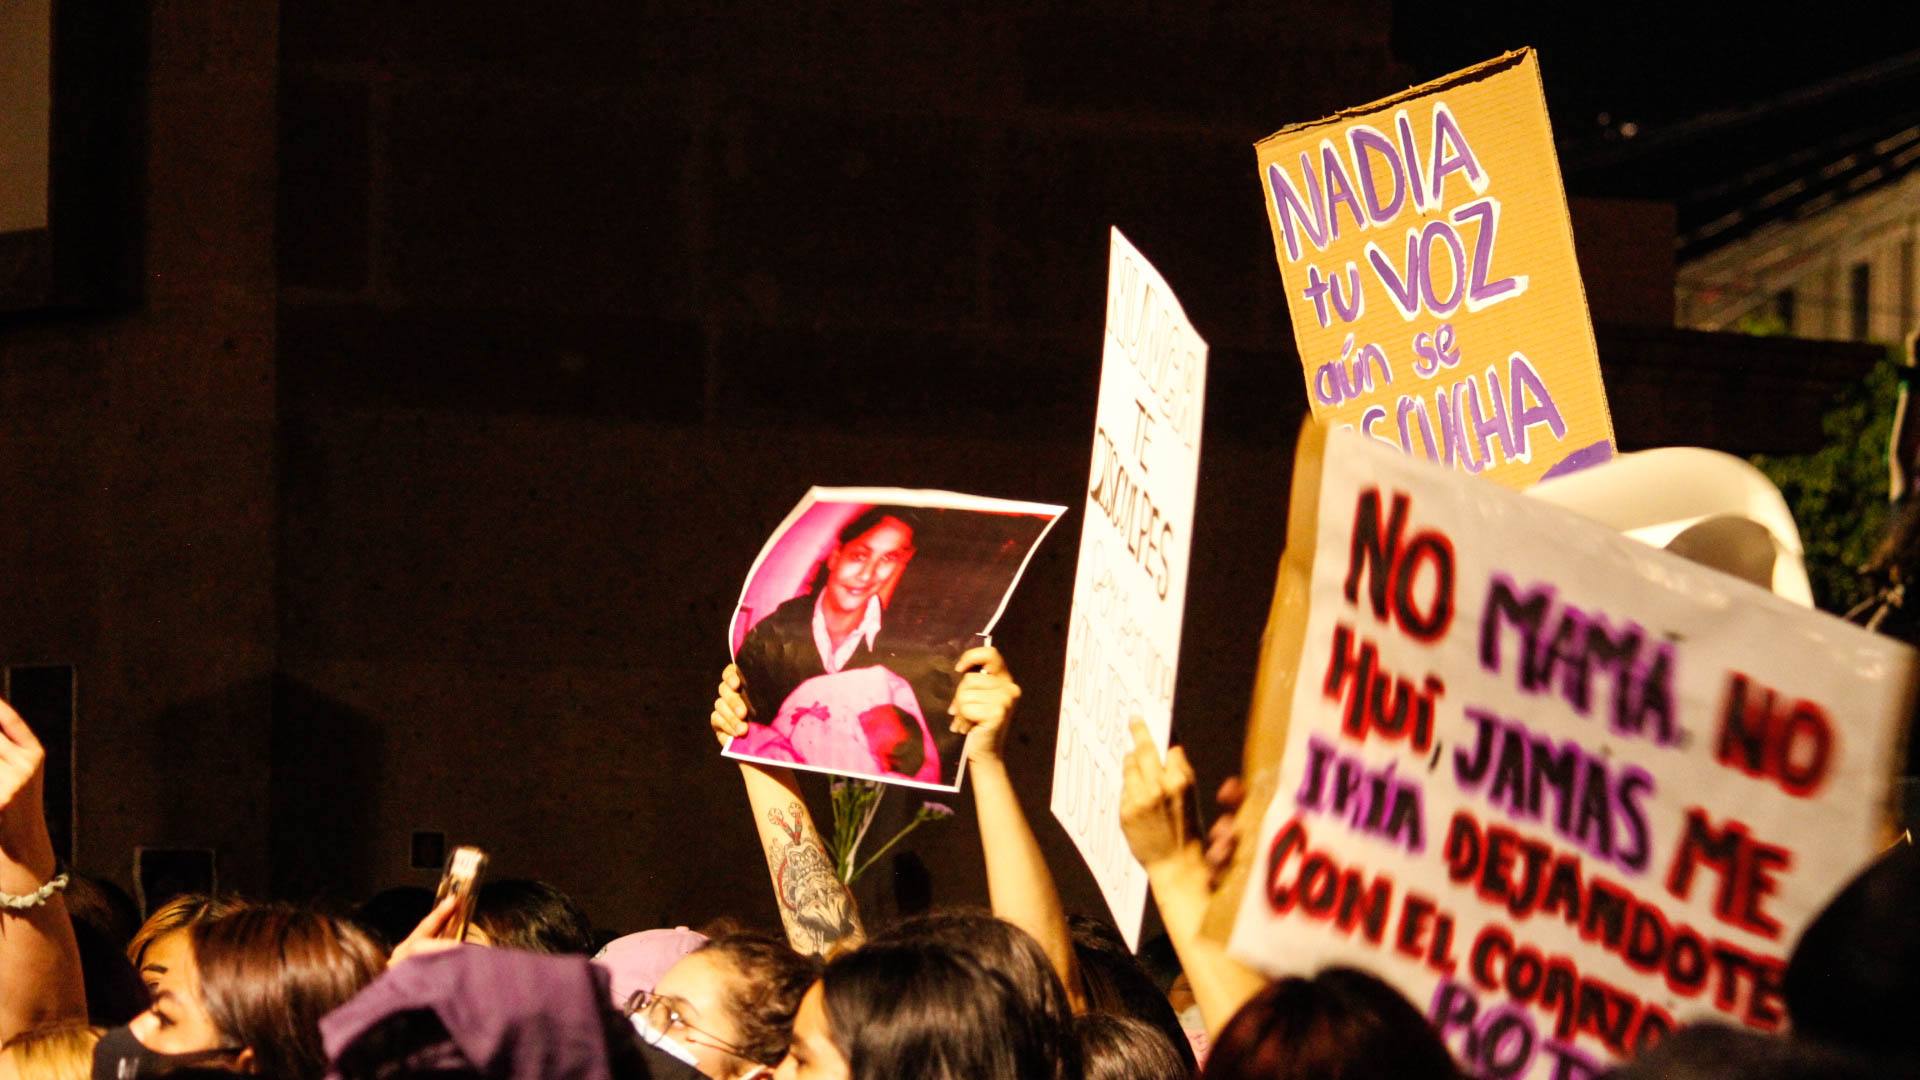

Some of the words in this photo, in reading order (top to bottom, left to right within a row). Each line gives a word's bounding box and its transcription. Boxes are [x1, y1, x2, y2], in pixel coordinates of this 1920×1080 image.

[1267, 101, 1490, 262] NADIA
[1303, 261, 1365, 328] tu
[1363, 196, 1529, 321] VOZ
[1133, 397, 1157, 475] TE
[1313, 332, 1393, 408] aún
[1412, 323, 1462, 379] se
[1337, 351, 1568, 474] SCUCHA
[1089, 426, 1174, 601] DISCULPES
[1345, 486, 1456, 644] NO
[1713, 669, 1837, 800] NO
[1265, 817, 1393, 950] CON
[1395, 890, 1458, 975] EL
[1444, 810, 1788, 1033] DEJANDOTE
[1666, 805, 1795, 941] ME
